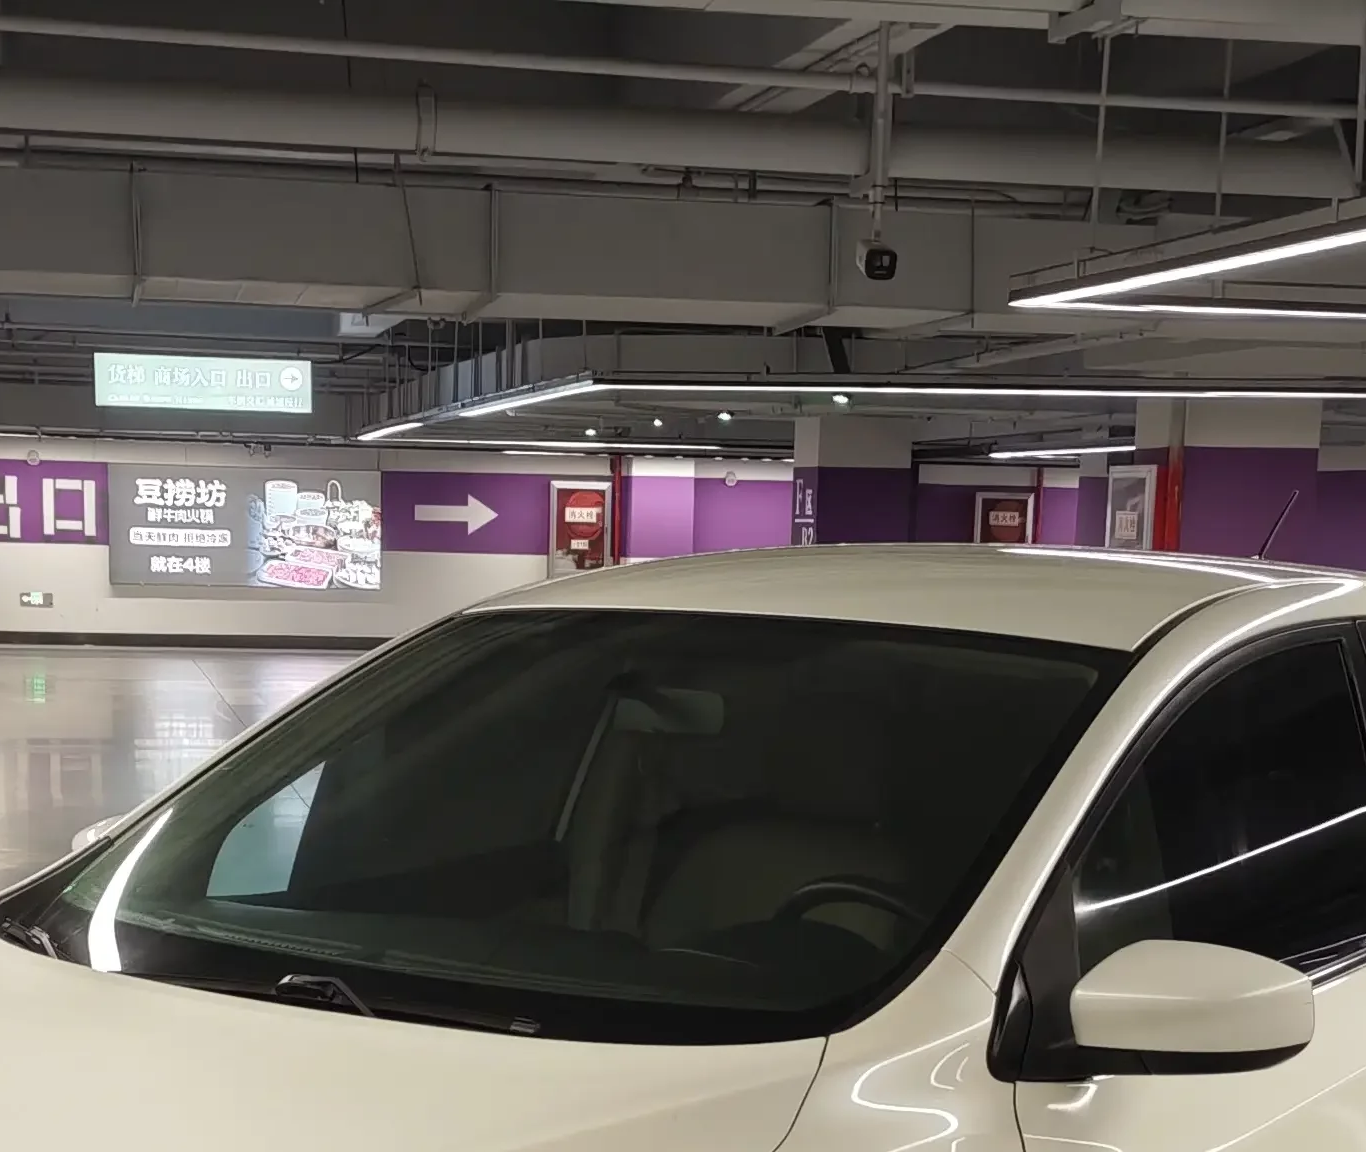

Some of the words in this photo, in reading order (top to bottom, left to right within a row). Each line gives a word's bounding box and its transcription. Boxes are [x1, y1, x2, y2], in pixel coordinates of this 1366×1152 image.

[108, 363, 146, 385] 货梯
[154, 366, 226, 388] 商场入口
[236, 369, 272, 389] 出口
[134, 478, 227, 507] 豆捞坊
[147, 507, 215, 524] 鲜牛肉火锅
[133, 530, 179, 543] 当天鲜肉
[150, 555, 212, 575] 就在4楼
